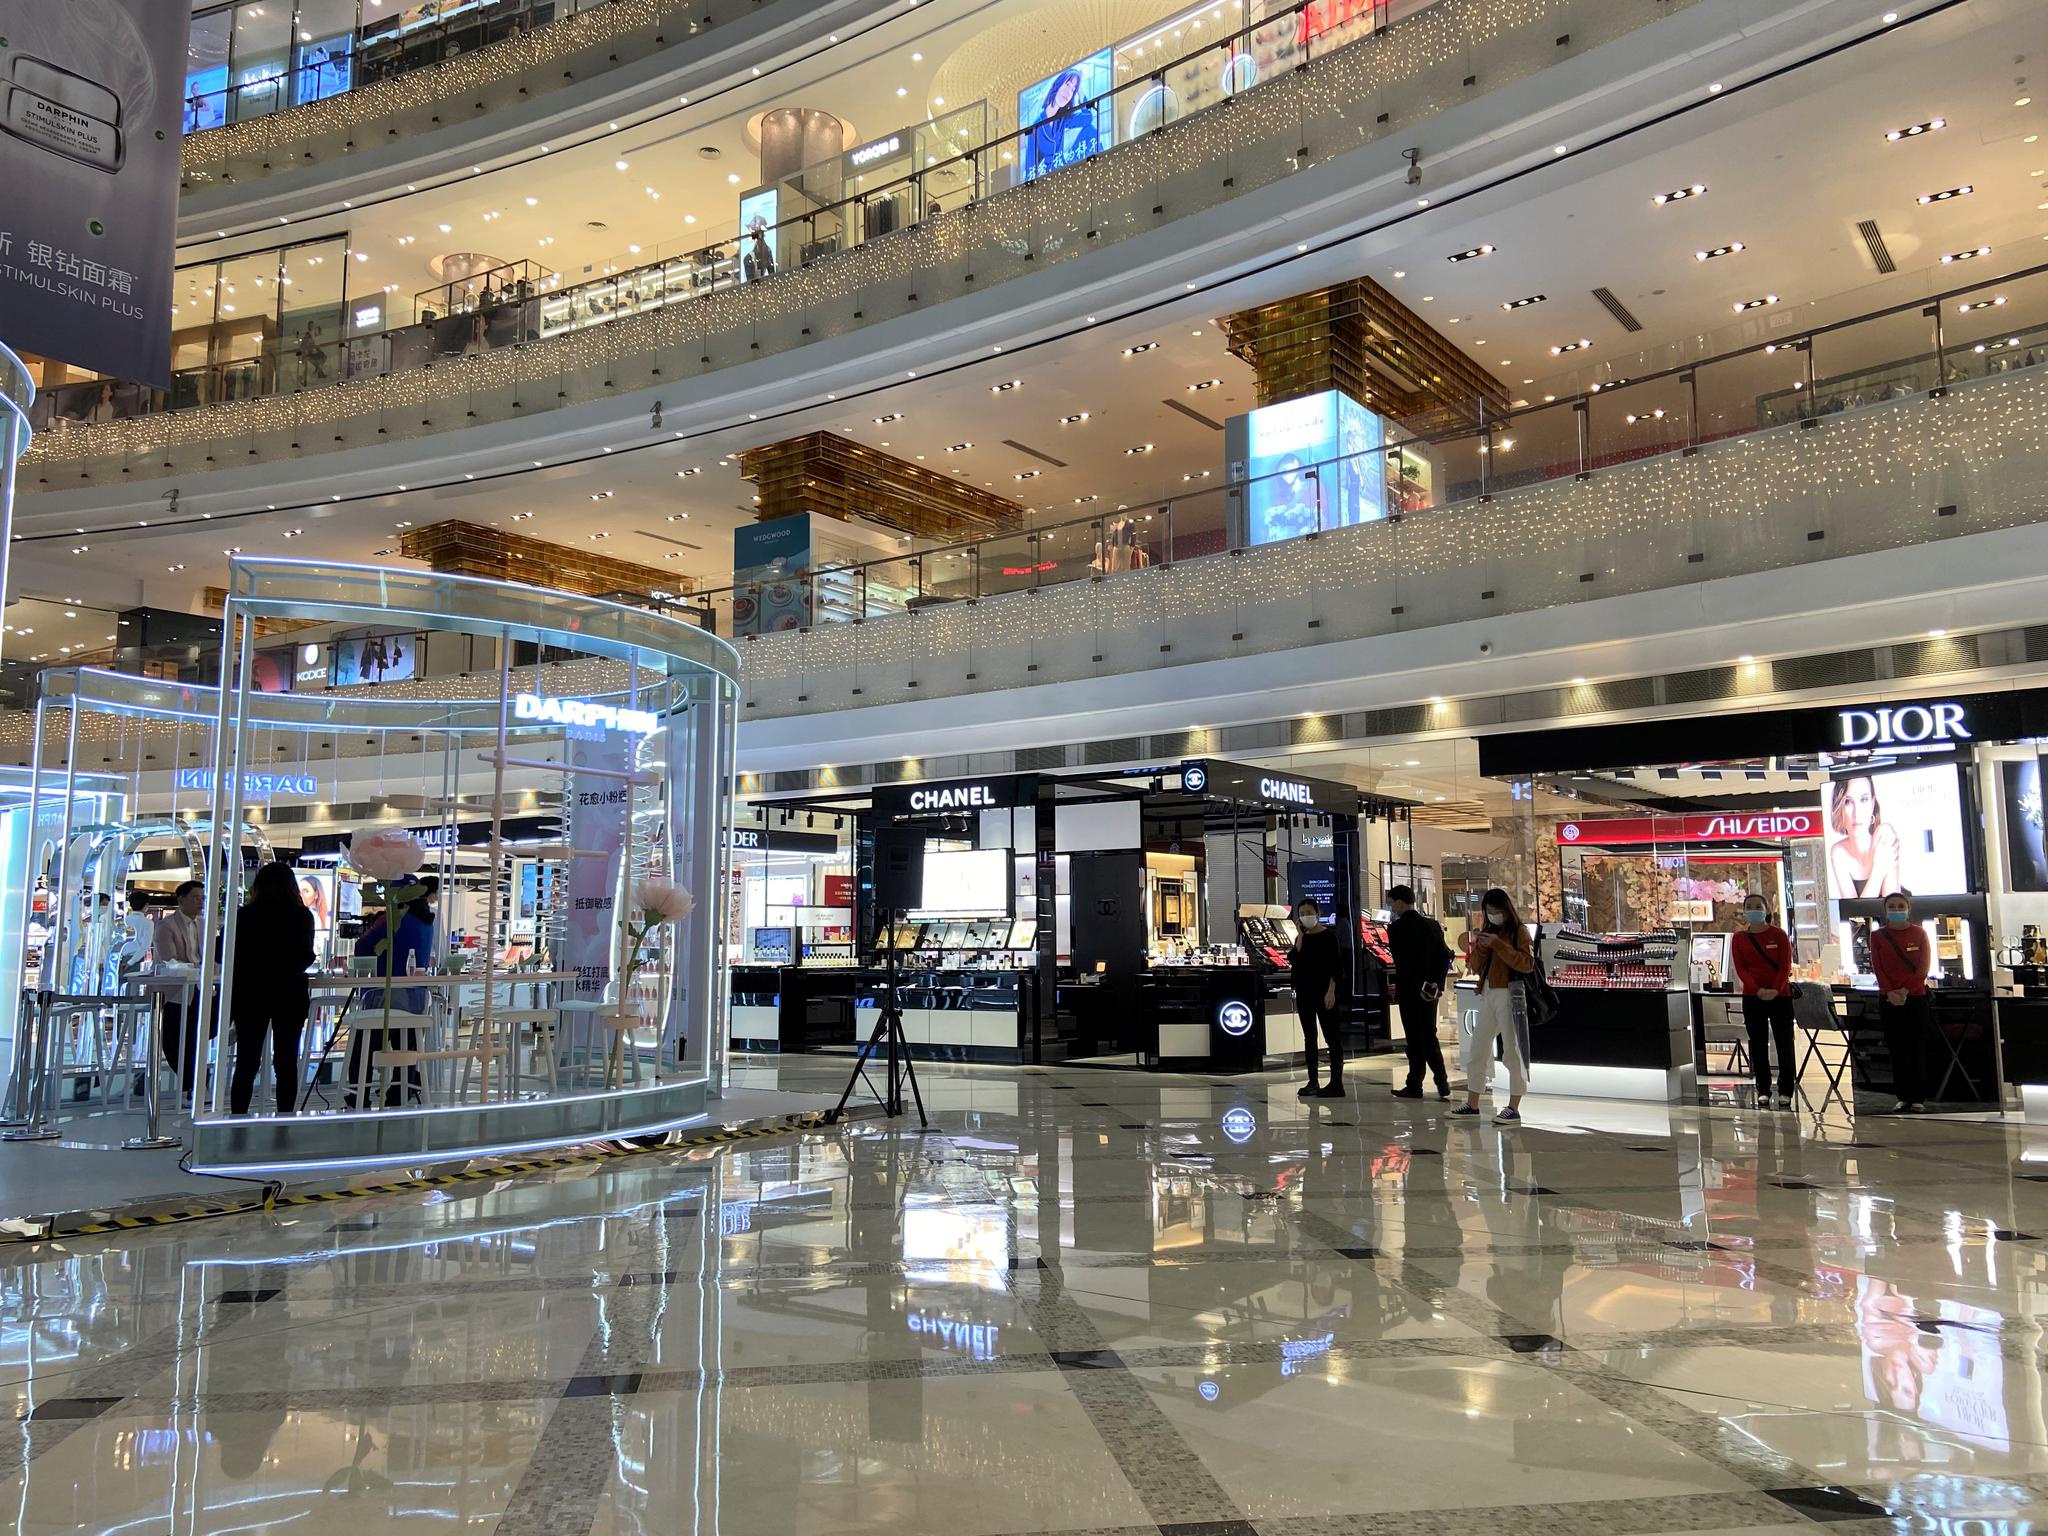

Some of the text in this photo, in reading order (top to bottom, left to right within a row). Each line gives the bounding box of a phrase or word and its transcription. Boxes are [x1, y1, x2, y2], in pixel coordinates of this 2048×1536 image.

[25, 110, 98, 144] STIMULSKIN PLUS
[37, 101, 89, 128] DARPHIN
[27, 240, 133, 296] 银钻面霜
[0, 263, 144, 320] TIMULSKIN PLUS
[1838, 702, 1972, 746] DIOR
[910, 786, 996, 810] CHANEL
[1260, 778, 1314, 804] CHANEL
[1697, 816, 1811, 837] SHISEIDO
